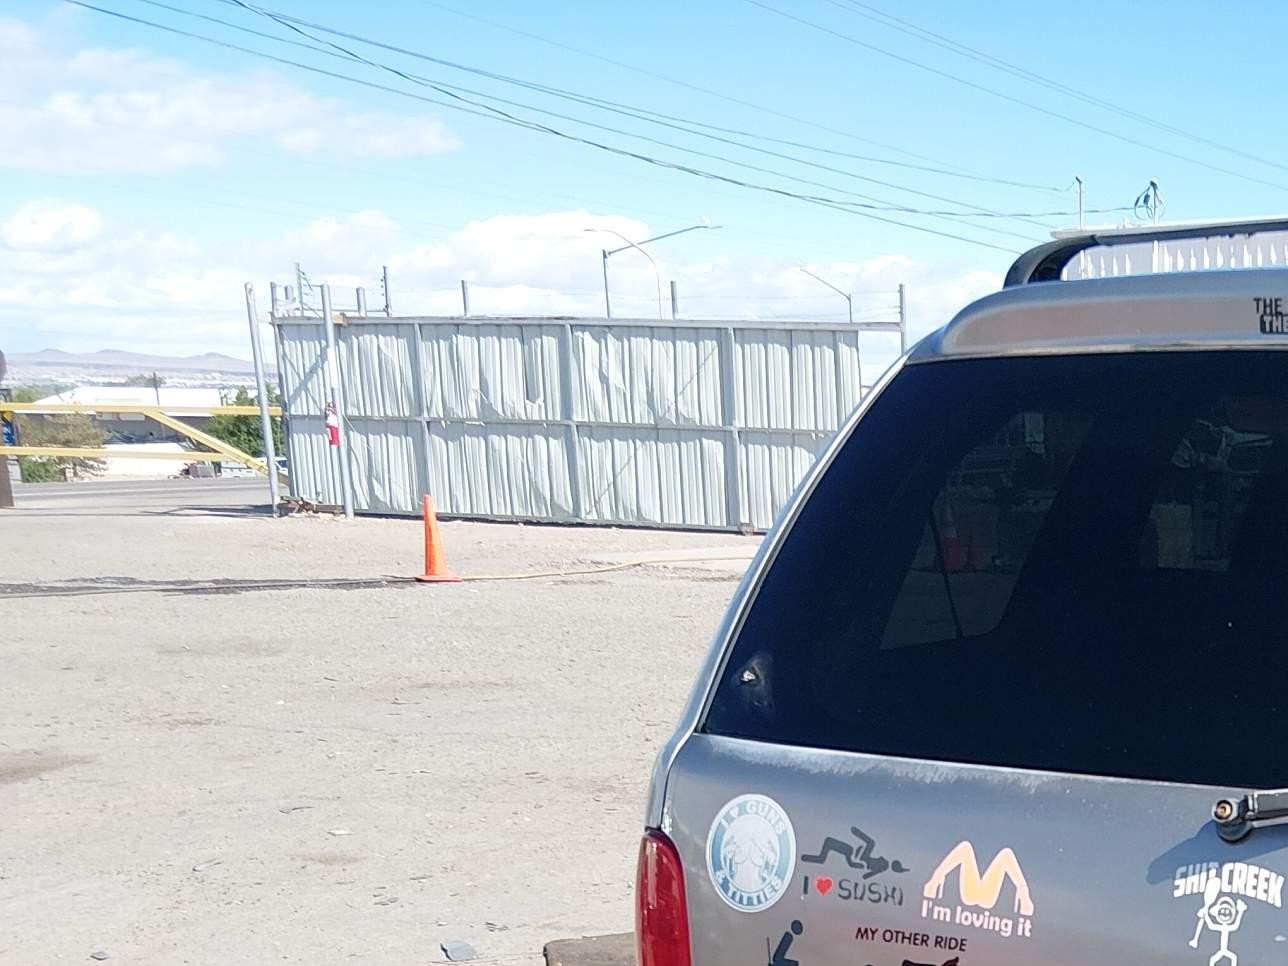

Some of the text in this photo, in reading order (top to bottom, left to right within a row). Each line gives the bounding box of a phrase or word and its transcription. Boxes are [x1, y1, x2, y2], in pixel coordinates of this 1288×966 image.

[1253, 297, 1282, 314] THE
[745, 800, 786, 835] GUNS
[803, 876, 904, 906] I SUSHI
[1221, 862, 1285, 908] CREEK
[921, 900, 1032, 937] I'm loving it
[856, 927, 968, 951] MY OTHER RIDE
